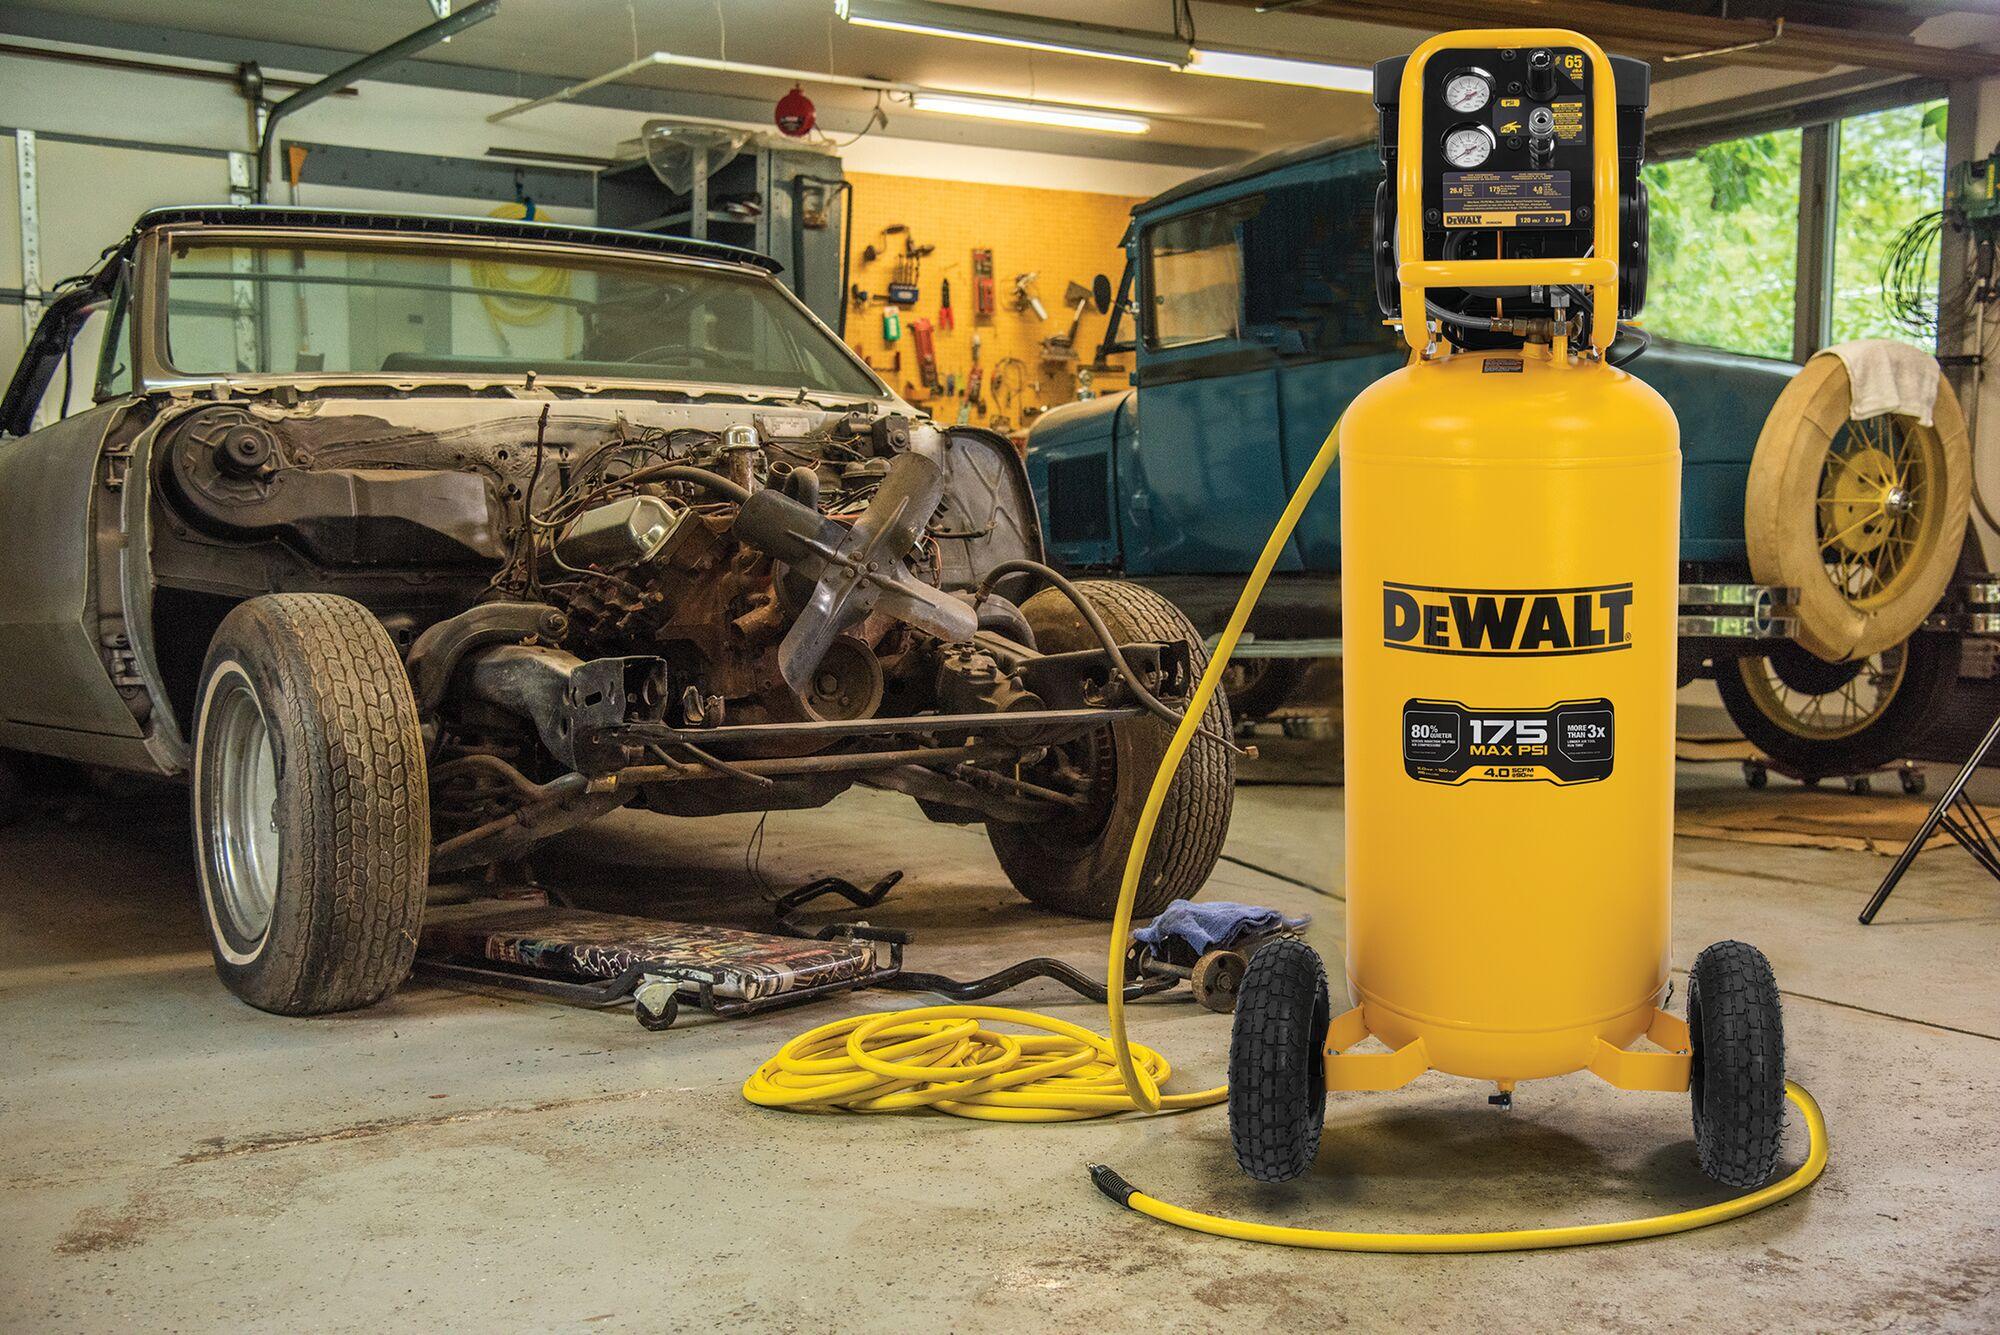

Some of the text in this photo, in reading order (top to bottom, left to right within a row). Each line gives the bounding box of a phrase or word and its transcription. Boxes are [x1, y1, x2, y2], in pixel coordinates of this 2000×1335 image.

[1565, 55, 1582, 68] 65
[1446, 215, 1482, 224] DEWALT
[1383, 588, 1633, 650] DEWALT
[1470, 720, 1548, 744] 175
[1470, 745, 1548, 756] MAX PSI
[1484, 768, 1510, 778] 4.0
